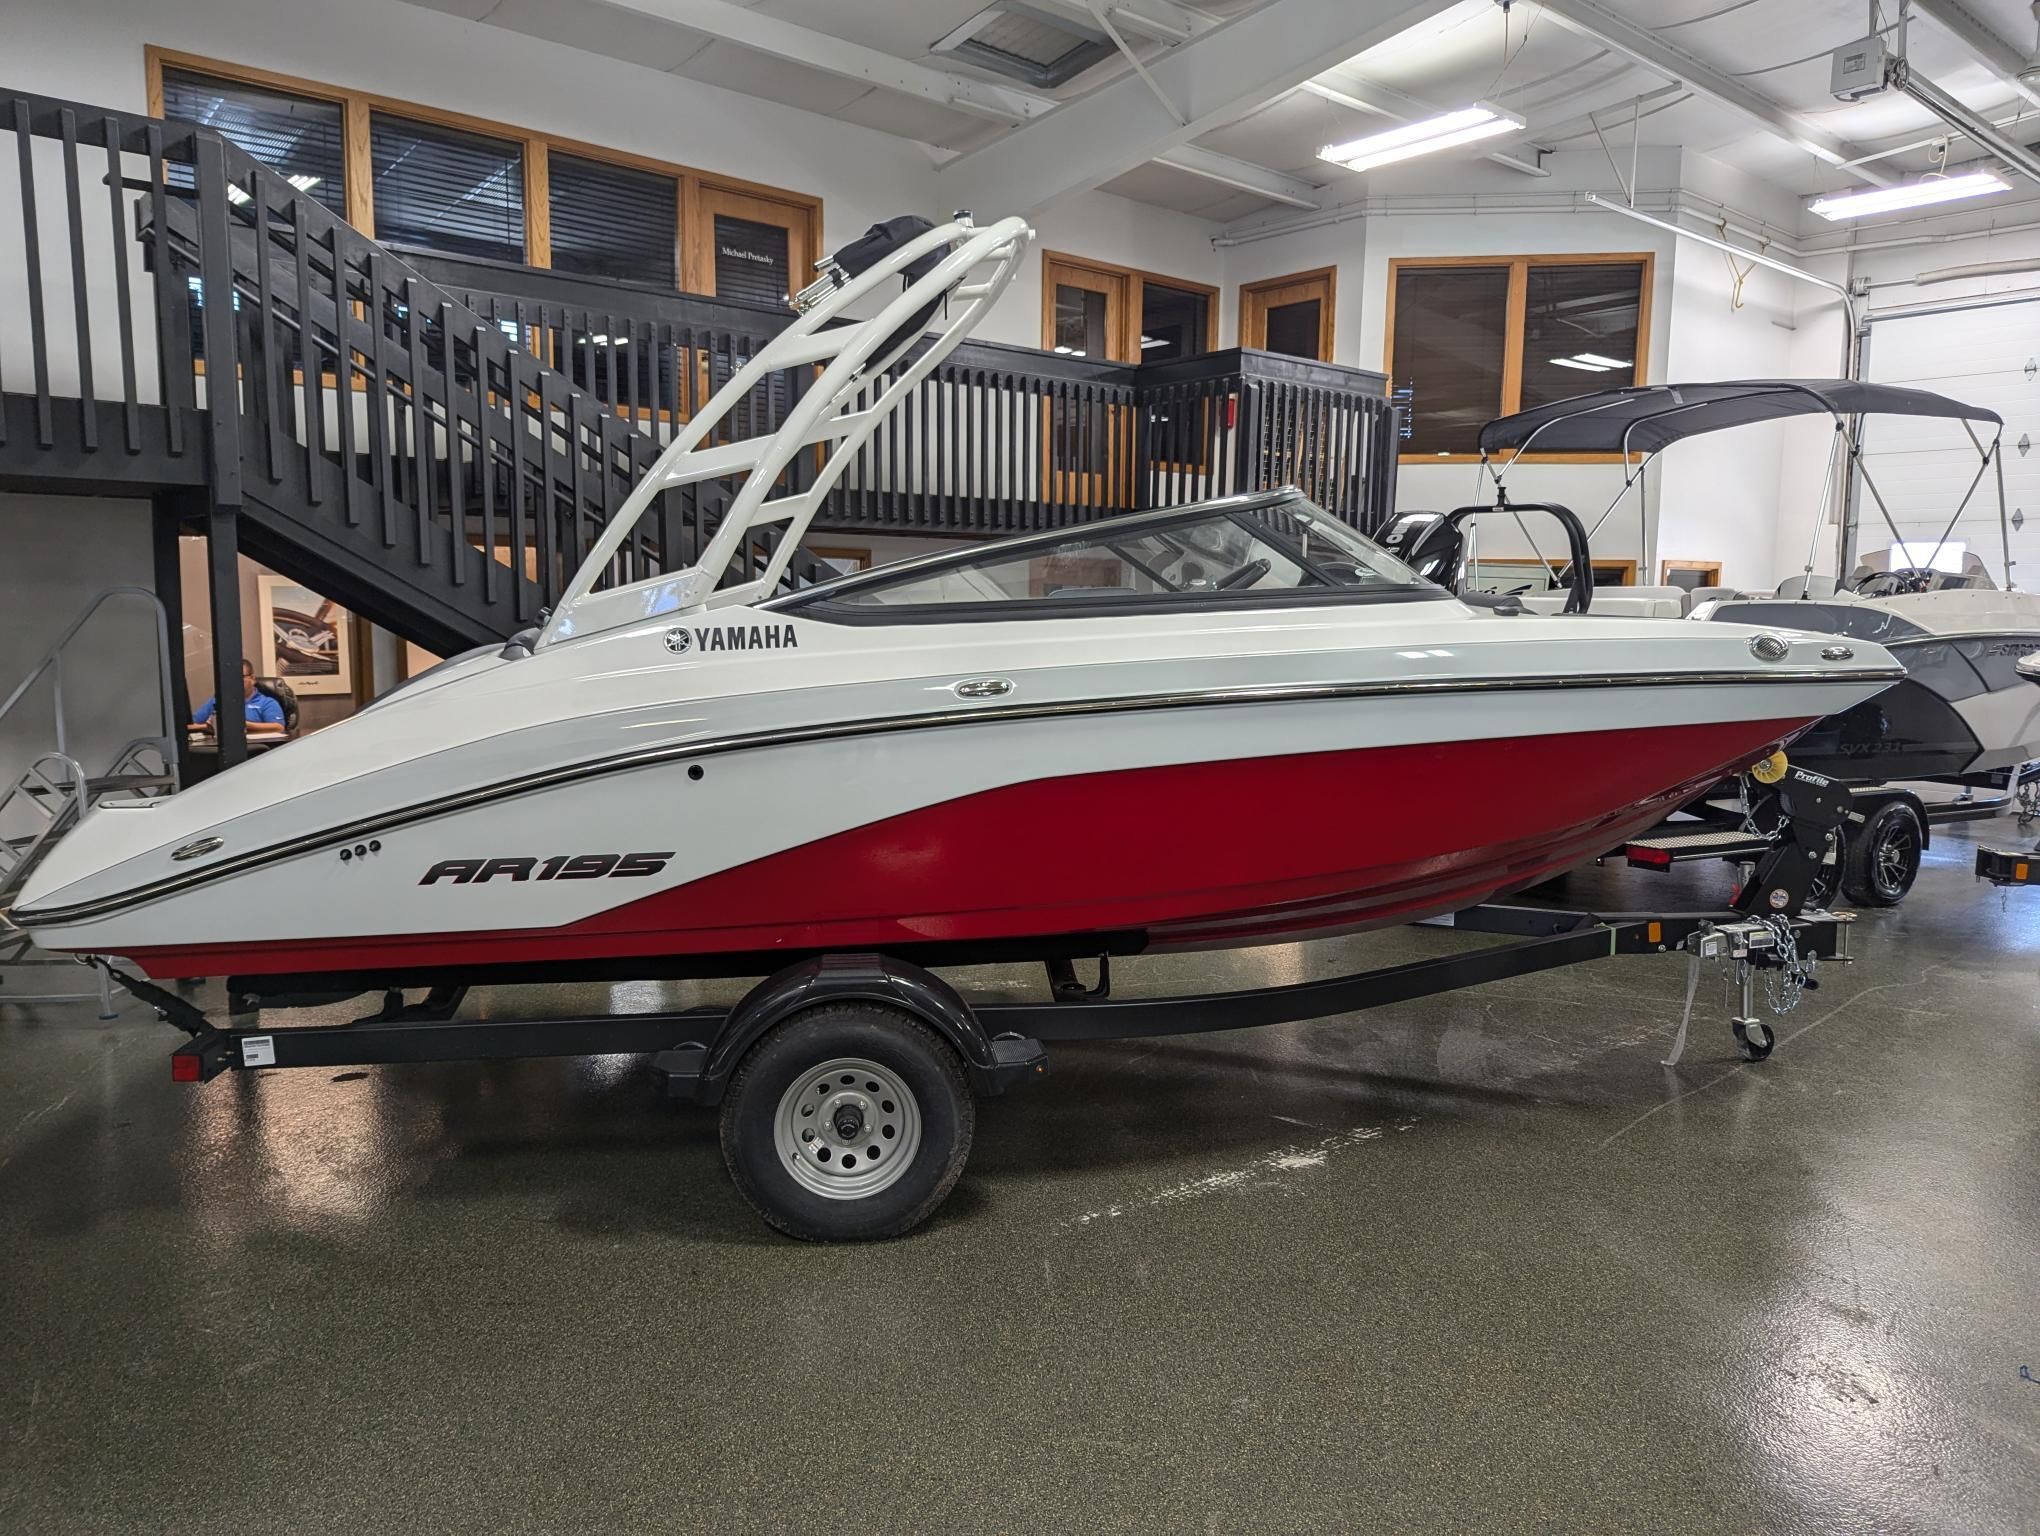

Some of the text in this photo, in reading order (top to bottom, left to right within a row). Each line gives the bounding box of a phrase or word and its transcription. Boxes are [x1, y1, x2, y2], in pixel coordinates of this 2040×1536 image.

[722, 247, 747, 259] Michael
[694, 624, 798, 652] YAMAHA
[1840, 743, 1870, 754] SVX
[1795, 770, 1830, 786] Profile
[417, 851, 677, 886] AR195
